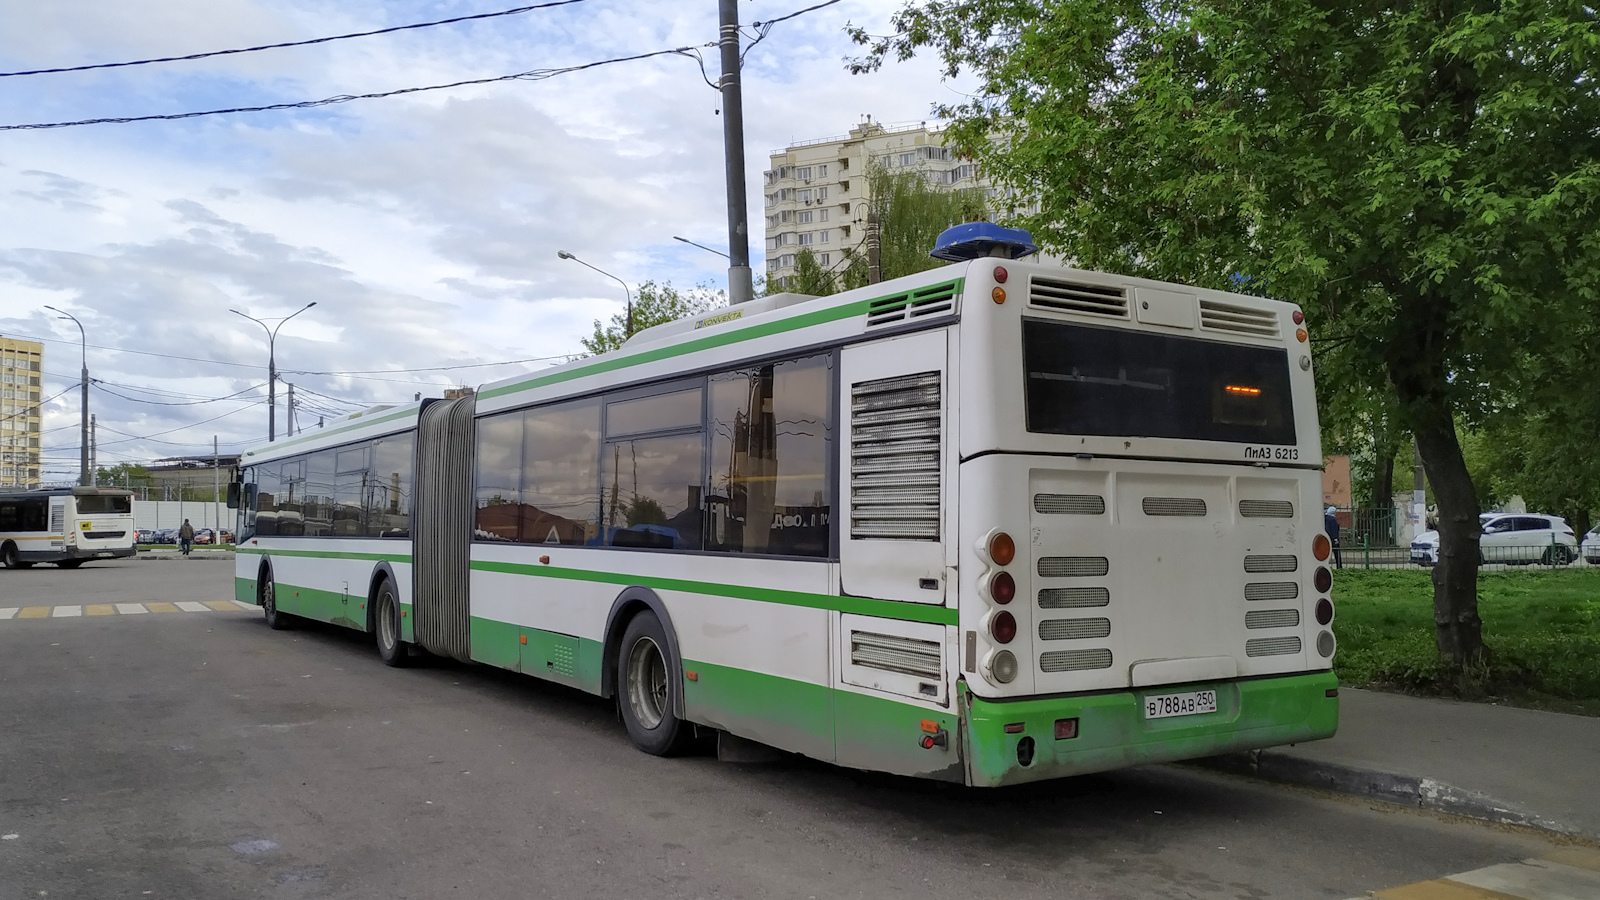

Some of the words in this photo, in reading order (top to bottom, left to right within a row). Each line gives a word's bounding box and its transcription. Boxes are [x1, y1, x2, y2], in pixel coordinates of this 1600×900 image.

[702, 311, 742, 327] KONVEKTA
[1244, 446, 1271, 459] ЛиАЗ
[1275, 448, 1299, 460] 6213
[1196, 692, 1214, 706] 250
